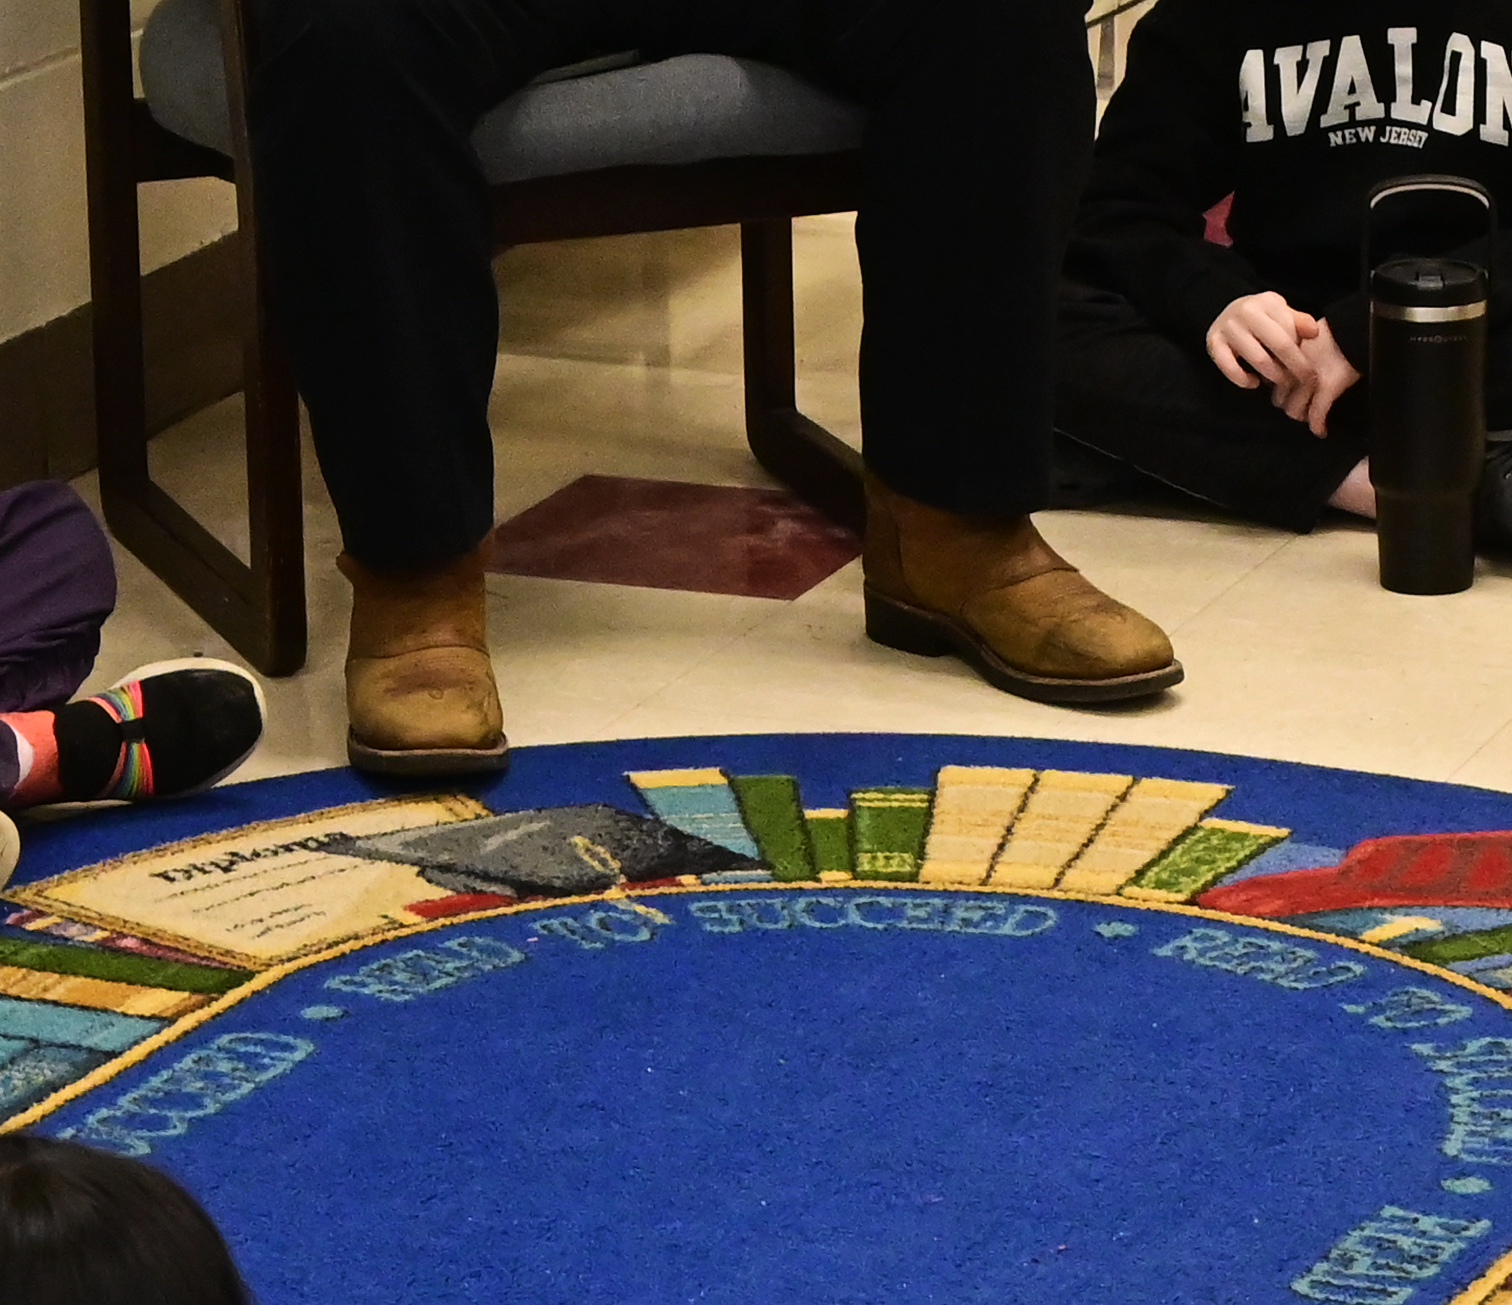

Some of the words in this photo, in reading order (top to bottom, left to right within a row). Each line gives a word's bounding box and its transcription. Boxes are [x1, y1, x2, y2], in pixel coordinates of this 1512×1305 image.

[1328, 125, 1377, 147] NEW
[1380, 125, 1429, 149] JERSEY
[690, 895, 1059, 937] SUCCEED
[56, 1032, 316, 1158] UCCEED
